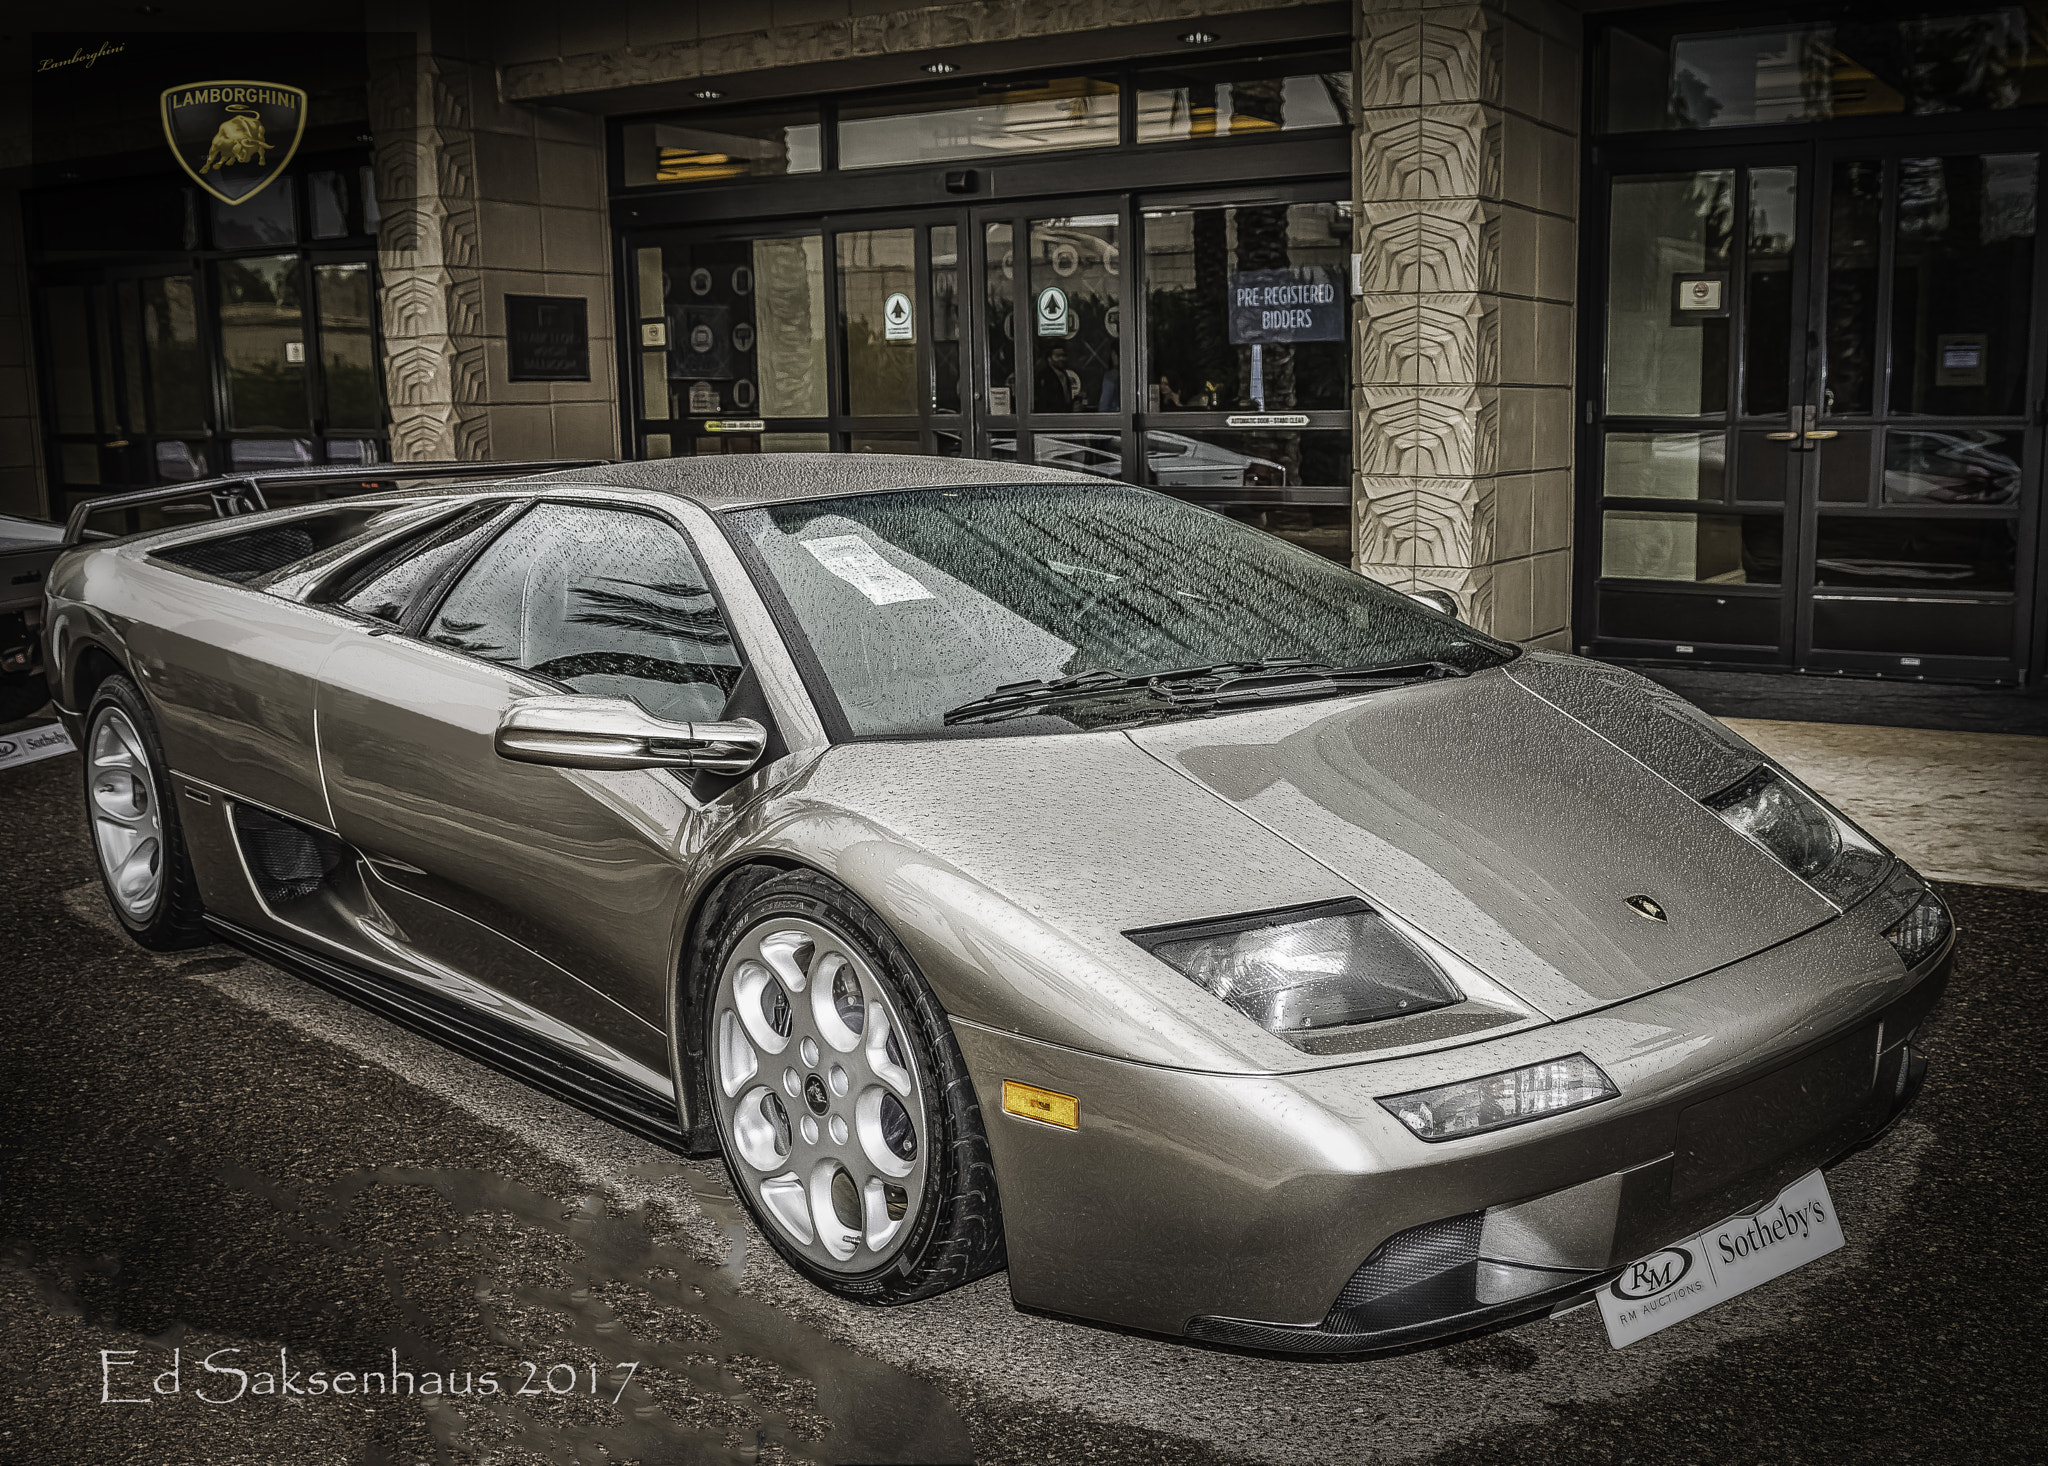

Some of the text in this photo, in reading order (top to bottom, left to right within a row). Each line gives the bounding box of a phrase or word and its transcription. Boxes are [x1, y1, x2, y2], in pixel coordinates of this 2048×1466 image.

[1236, 284, 1334, 307] PRE-REGISTERED
[1262, 309, 1313, 330] BIDDERS
[1717, 1200, 1826, 1265] Sotheby's
[1630, 1260, 1673, 1292] RM
[1619, 1281, 1703, 1326] RM AUCTIONS
